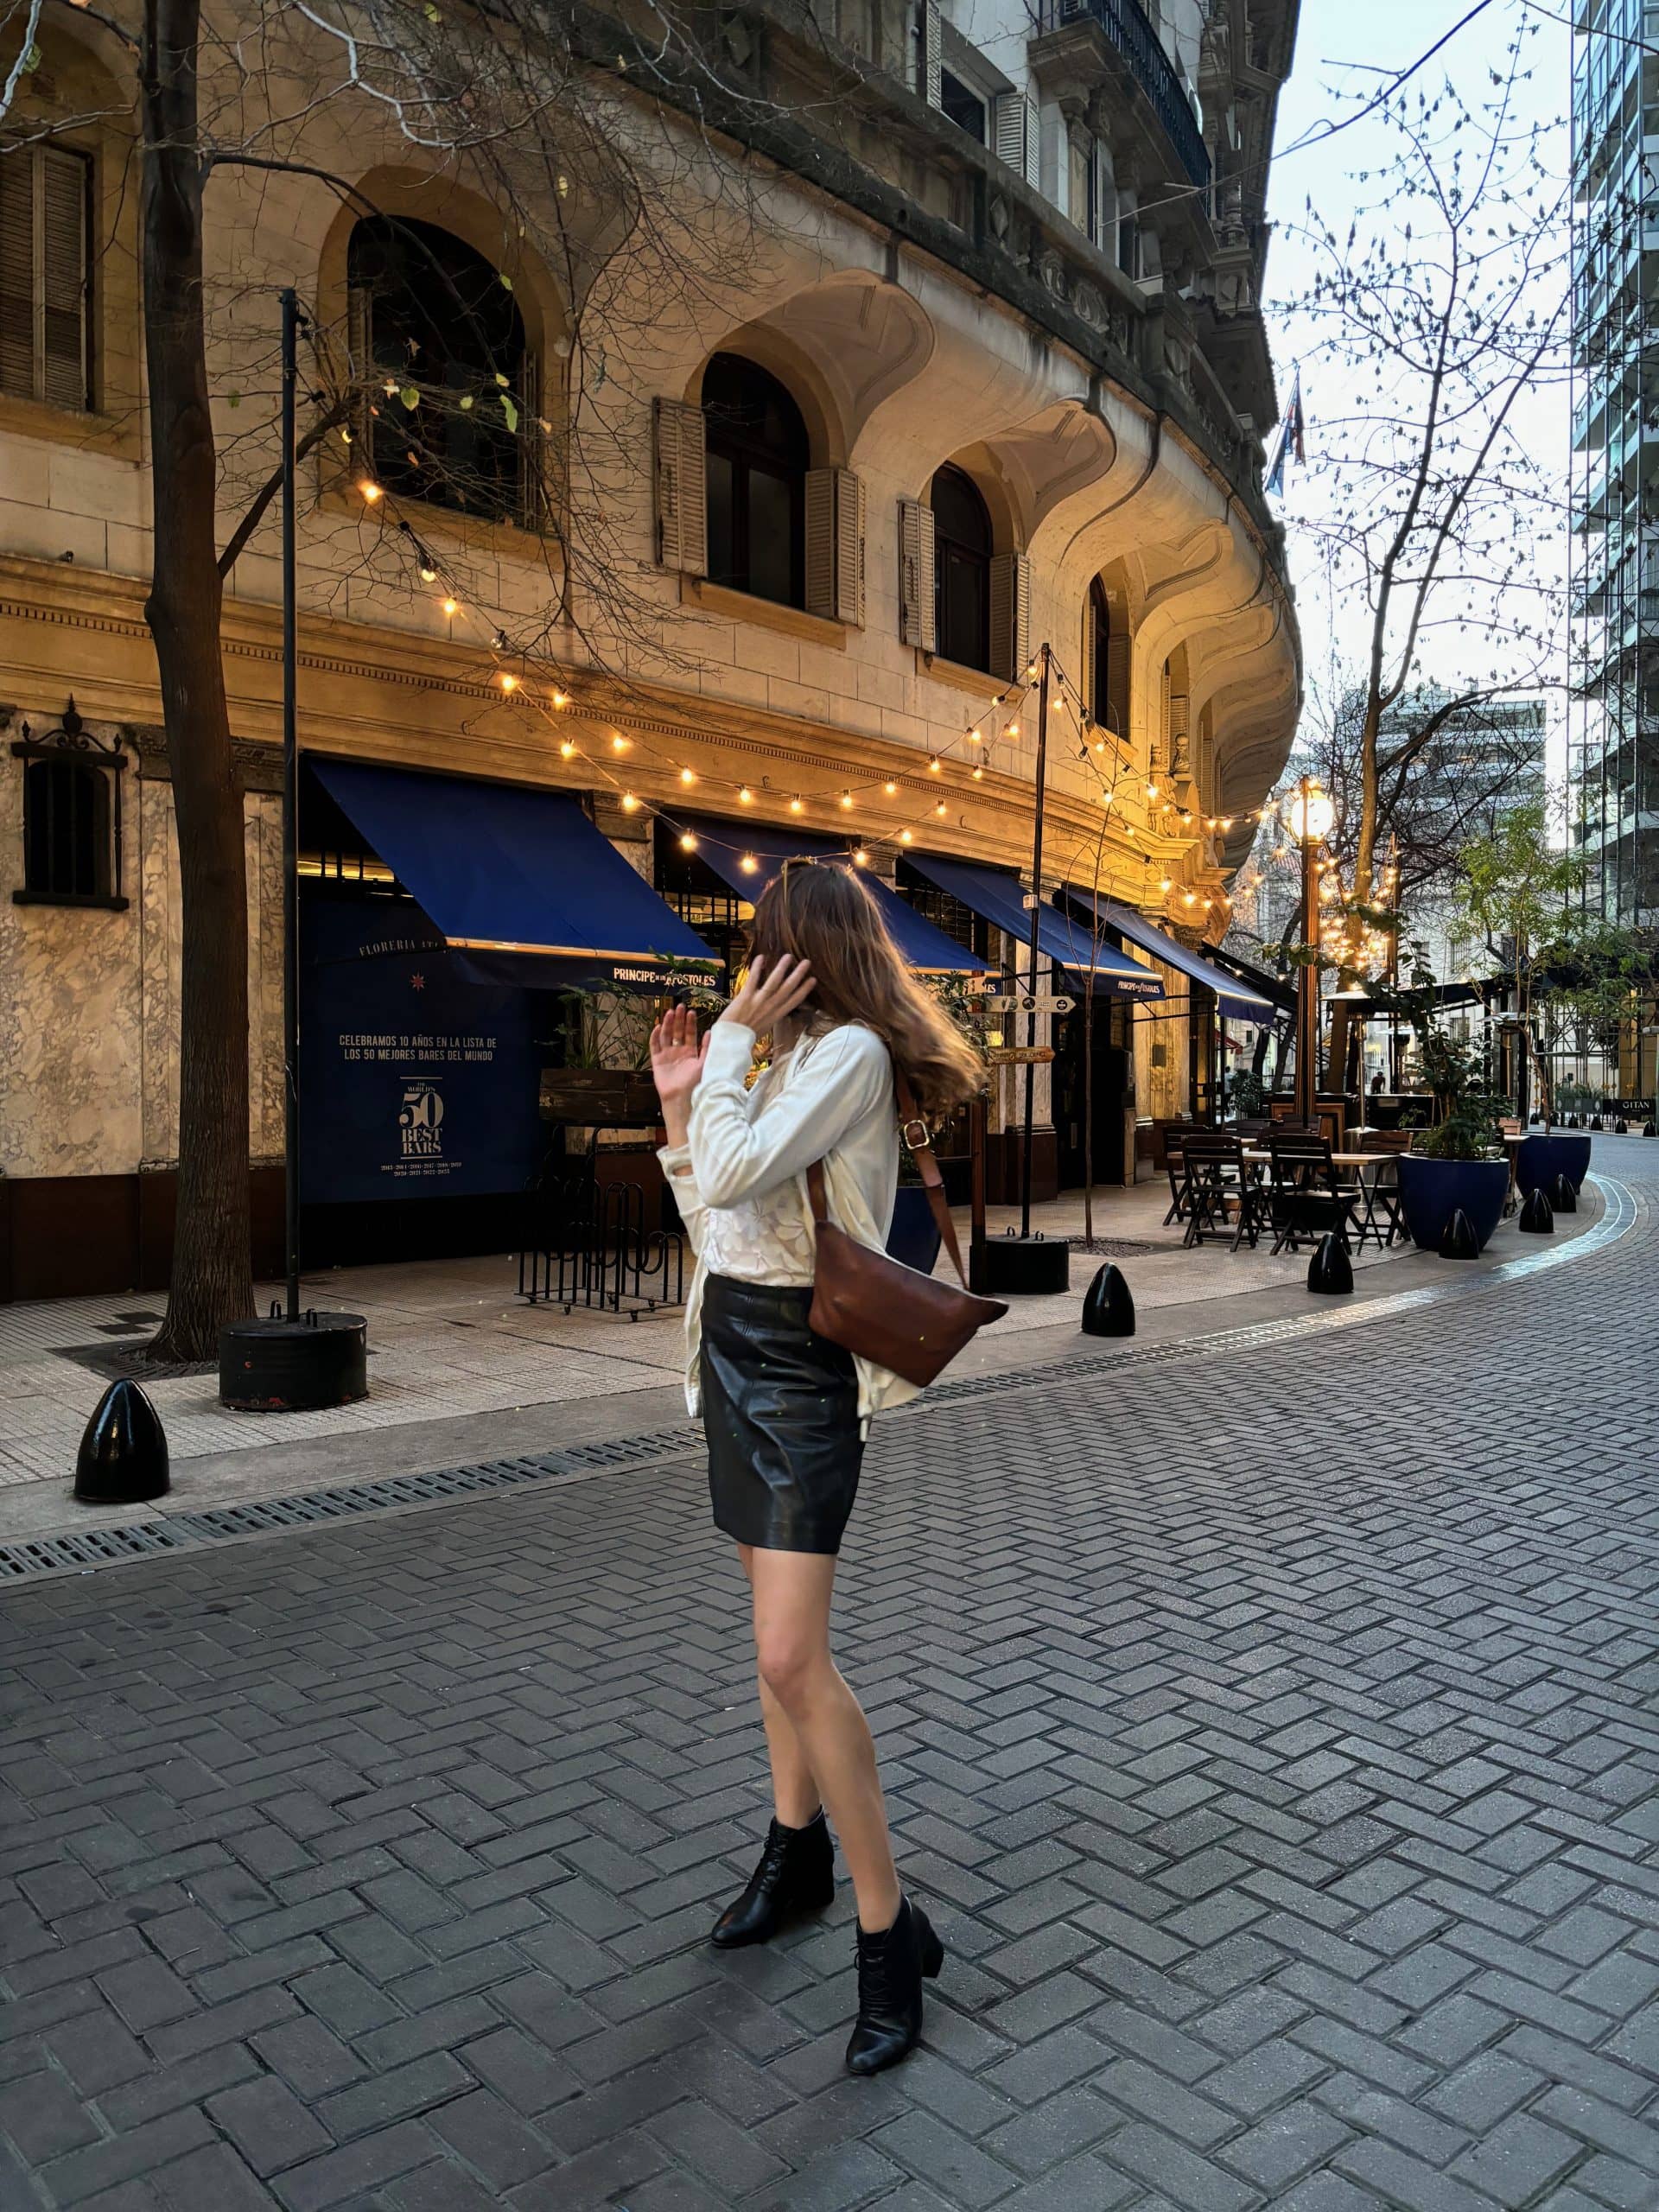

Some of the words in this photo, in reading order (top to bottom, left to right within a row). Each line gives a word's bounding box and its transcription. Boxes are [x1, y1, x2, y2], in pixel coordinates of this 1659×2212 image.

[613, 967, 656, 983] PRINCIPE
[339, 1034, 397, 1046] CELEBRAMOS
[399, 1035, 409, 1046] 10
[411, 1033, 434, 1047] AÑOS
[436, 1036, 448, 1047] EN
[449, 1036, 461, 1048] LA
[462, 1036, 485, 1048] LISTA
[486, 1038, 498, 1048] DE
[344, 1048, 361, 1059] LOS
[363, 1048, 375, 1059] 50
[378, 1048, 416, 1060] MEJORES
[418, 1049, 445, 1061] BARES
[448, 1050, 462, 1061] DEL
[464, 1050, 493, 1061] MUNDO
[399, 1092, 444, 1128] 50
[402, 1128, 443, 1142] BEST
[403, 1141, 442, 1154] BARS
